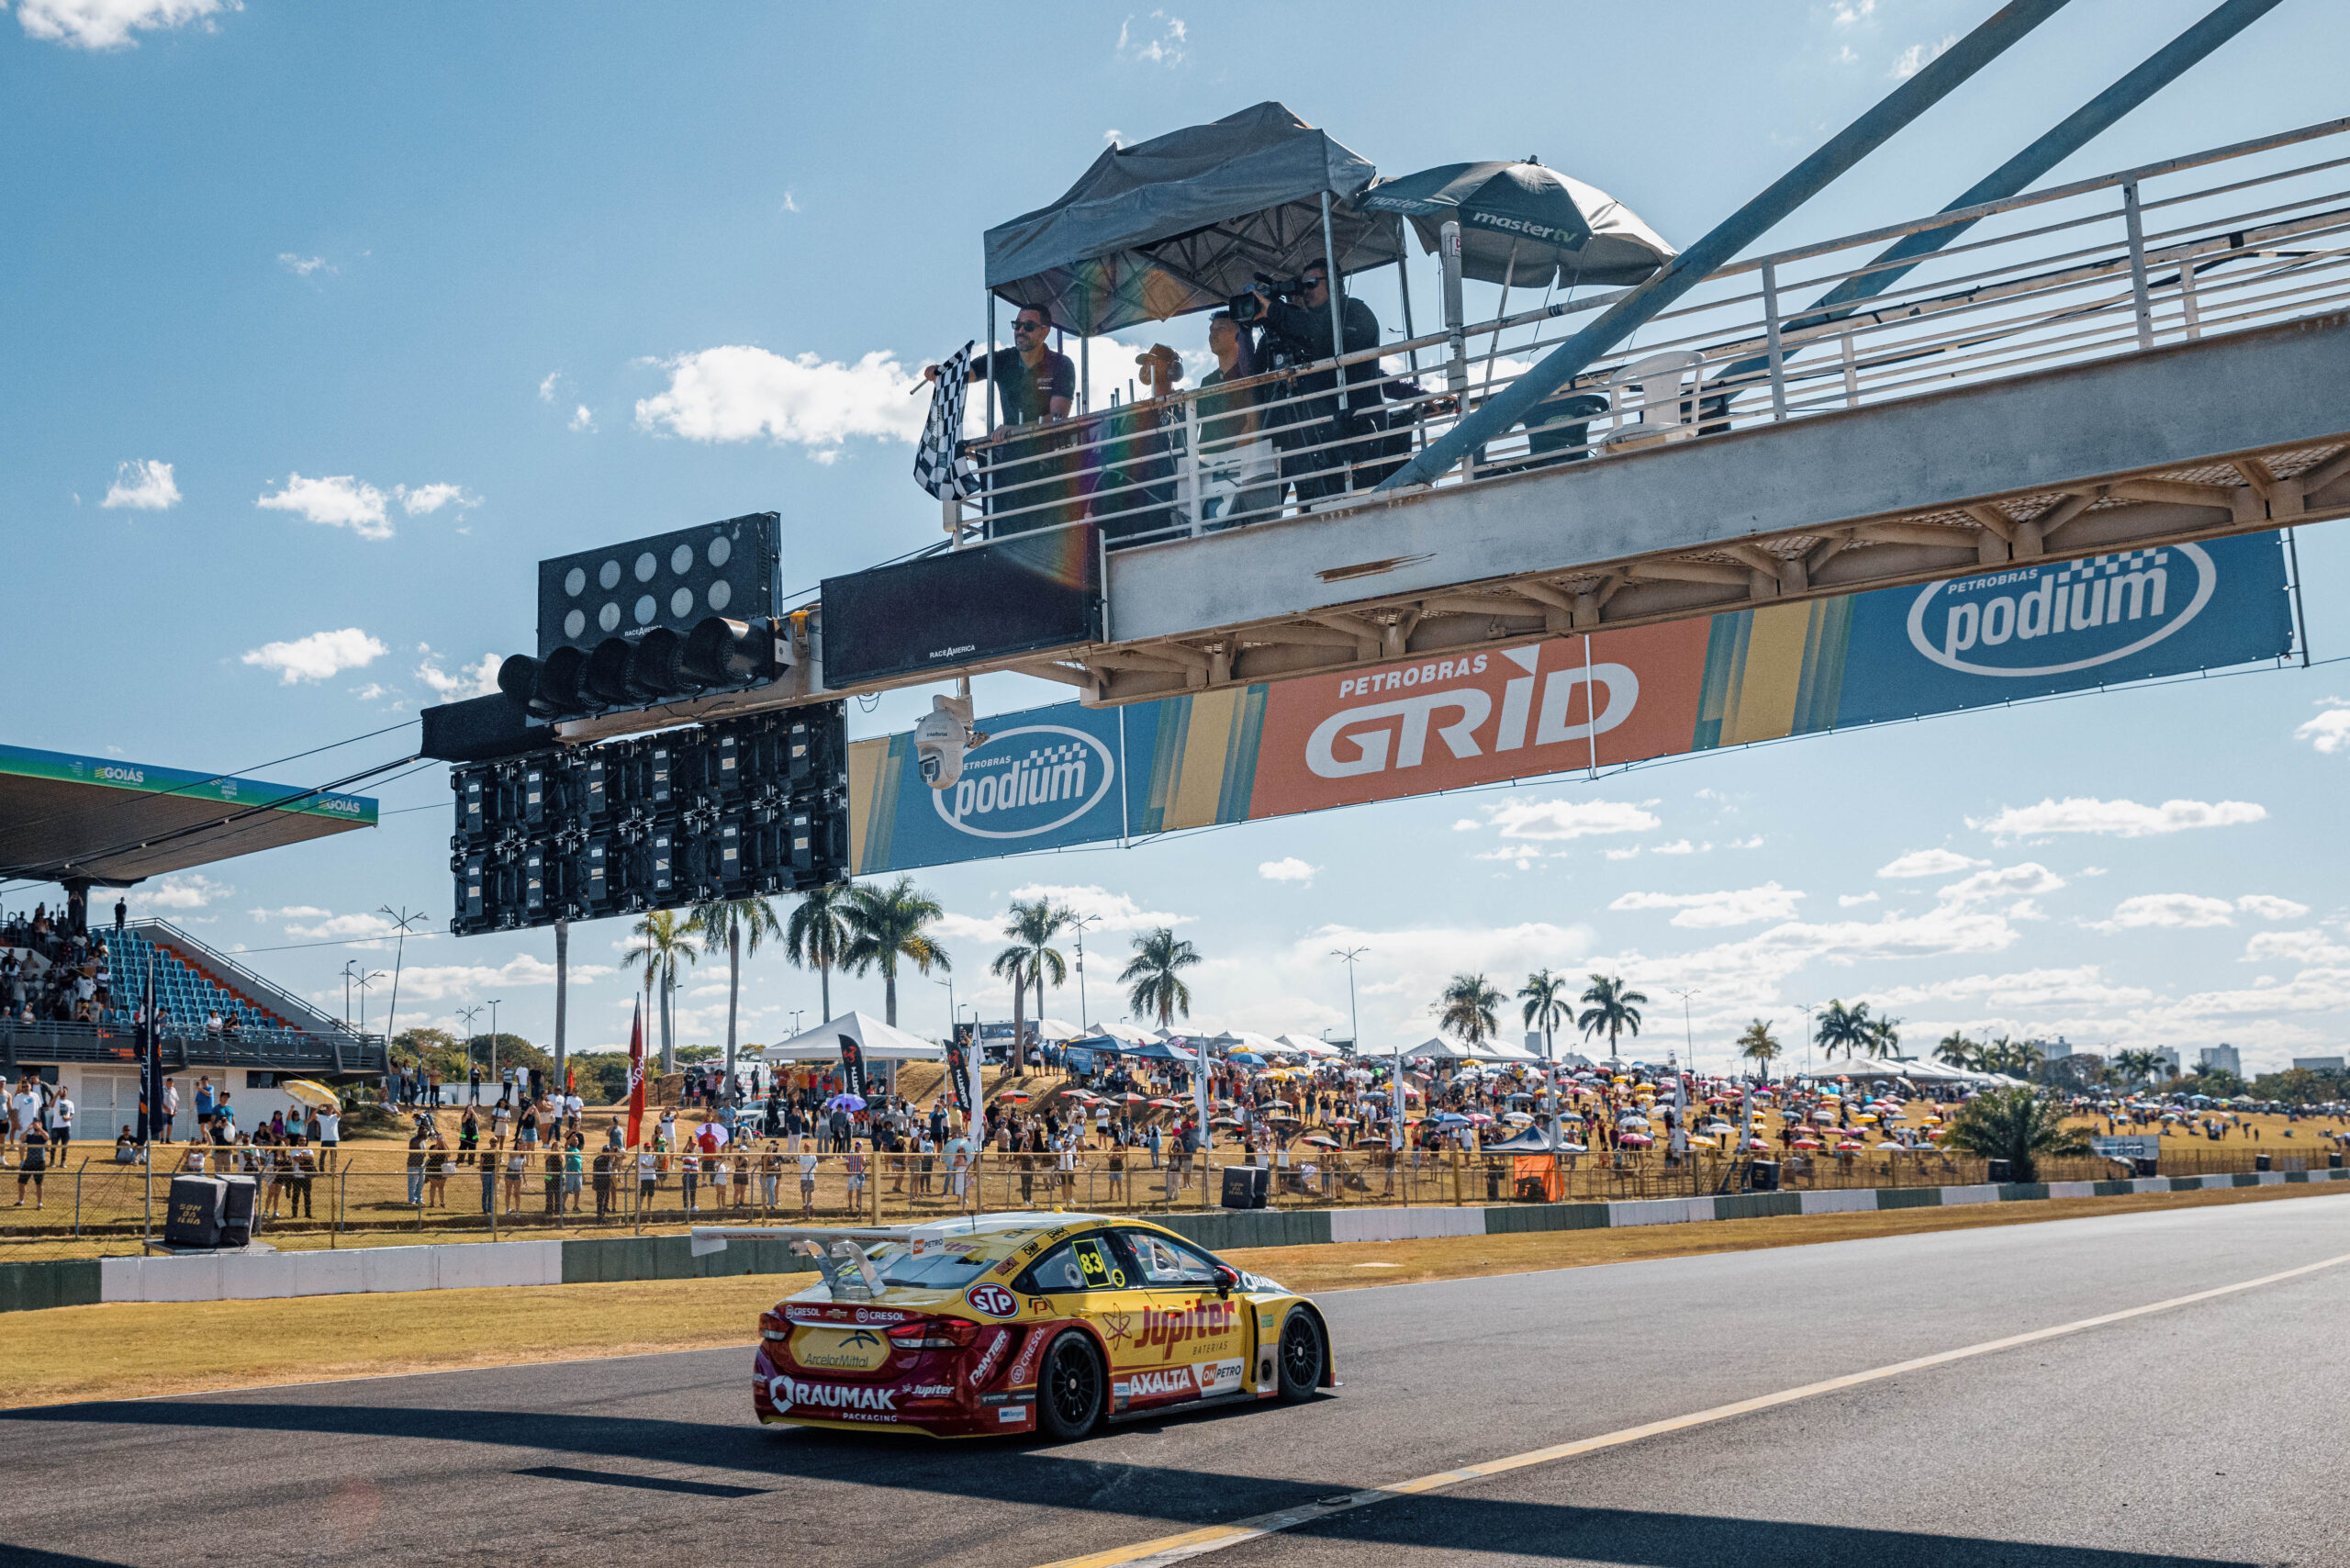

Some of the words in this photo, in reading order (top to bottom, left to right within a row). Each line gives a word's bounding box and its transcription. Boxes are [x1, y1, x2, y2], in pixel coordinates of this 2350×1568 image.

[1472, 211, 1578, 244] mastertv
[1947, 568, 2038, 595] PETROBRAS
[1944, 566, 2168, 661] podium
[929, 644, 976, 658] RACEAMERICA
[1338, 655, 1487, 698] PETROBRAS
[1305, 644, 1639, 778] GRID
[104, 766, 143, 783] GOIÁS
[955, 759, 1087, 823] podium
[956, 1069, 969, 1109] ABARTH
[1024, 1242, 1039, 1256] OMP
[1080, 1252, 1103, 1273] 83
[794, 1308, 821, 1316] CRESOL
[974, 1288, 1012, 1313] STP
[869, 1311, 905, 1321] CRESOL
[1134, 1299, 1235, 1360] Jupiter
[804, 1353, 868, 1367] ArcelorMittal
[969, 1330, 1007, 1386] PANTER
[1021, 1327, 1046, 1367] CRESOL
[1192, 1340, 1228, 1356] BATERIAS
[1129, 1368, 1192, 1395] AXALTA
[1203, 1369, 1216, 1382] ON
[1216, 1365, 1241, 1378] PETRO
[795, 1383, 897, 1410] RAUMAK
[912, 1384, 955, 1397] Jupiter
[843, 1412, 898, 1422] PACKAGING
